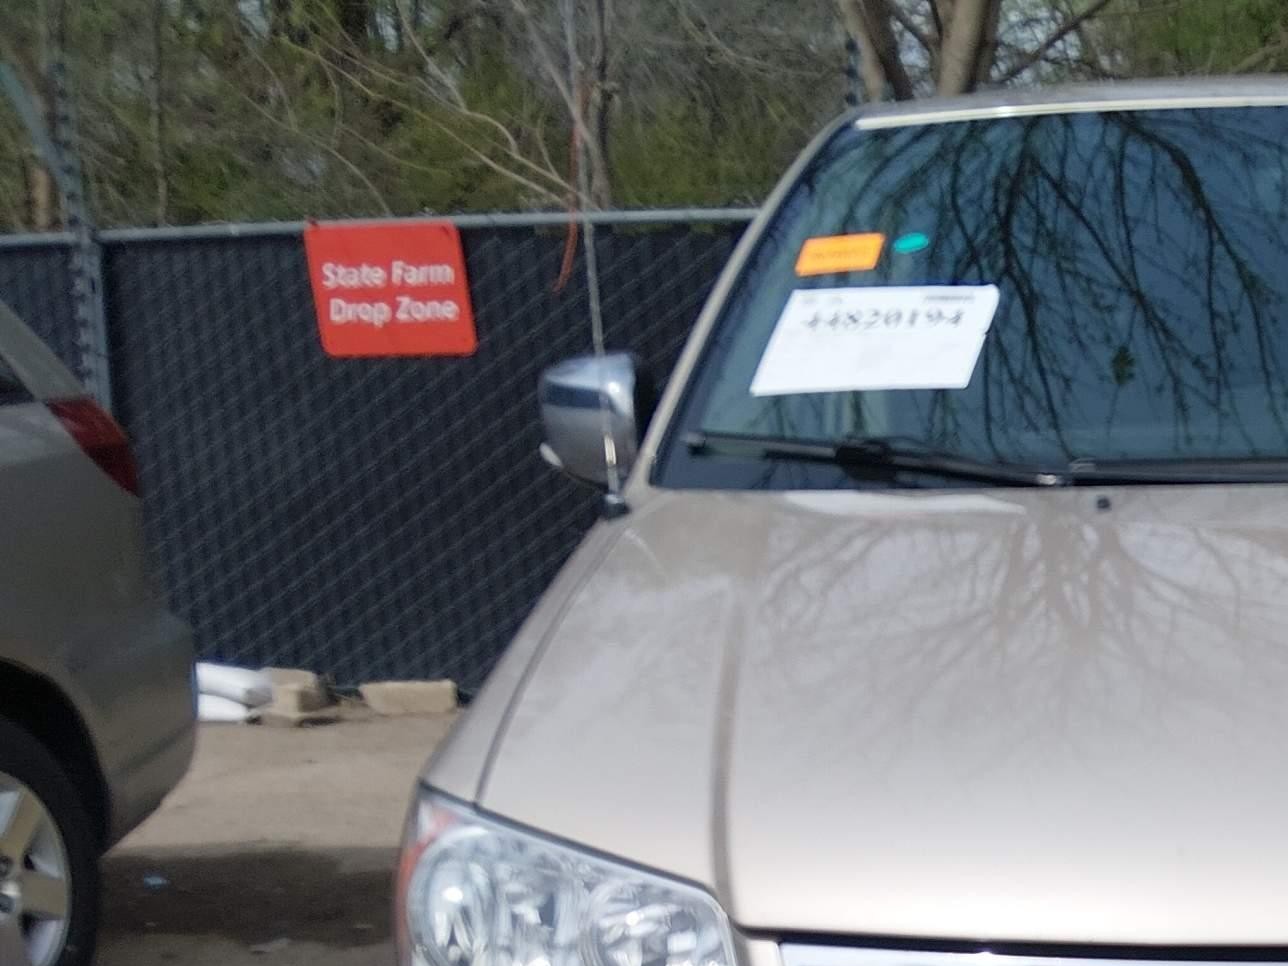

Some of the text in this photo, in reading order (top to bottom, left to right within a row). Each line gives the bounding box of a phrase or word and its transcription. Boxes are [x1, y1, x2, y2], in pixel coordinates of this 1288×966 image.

[322, 260, 455, 289] State Farm
[329, 295, 459, 328] Drop Zone
